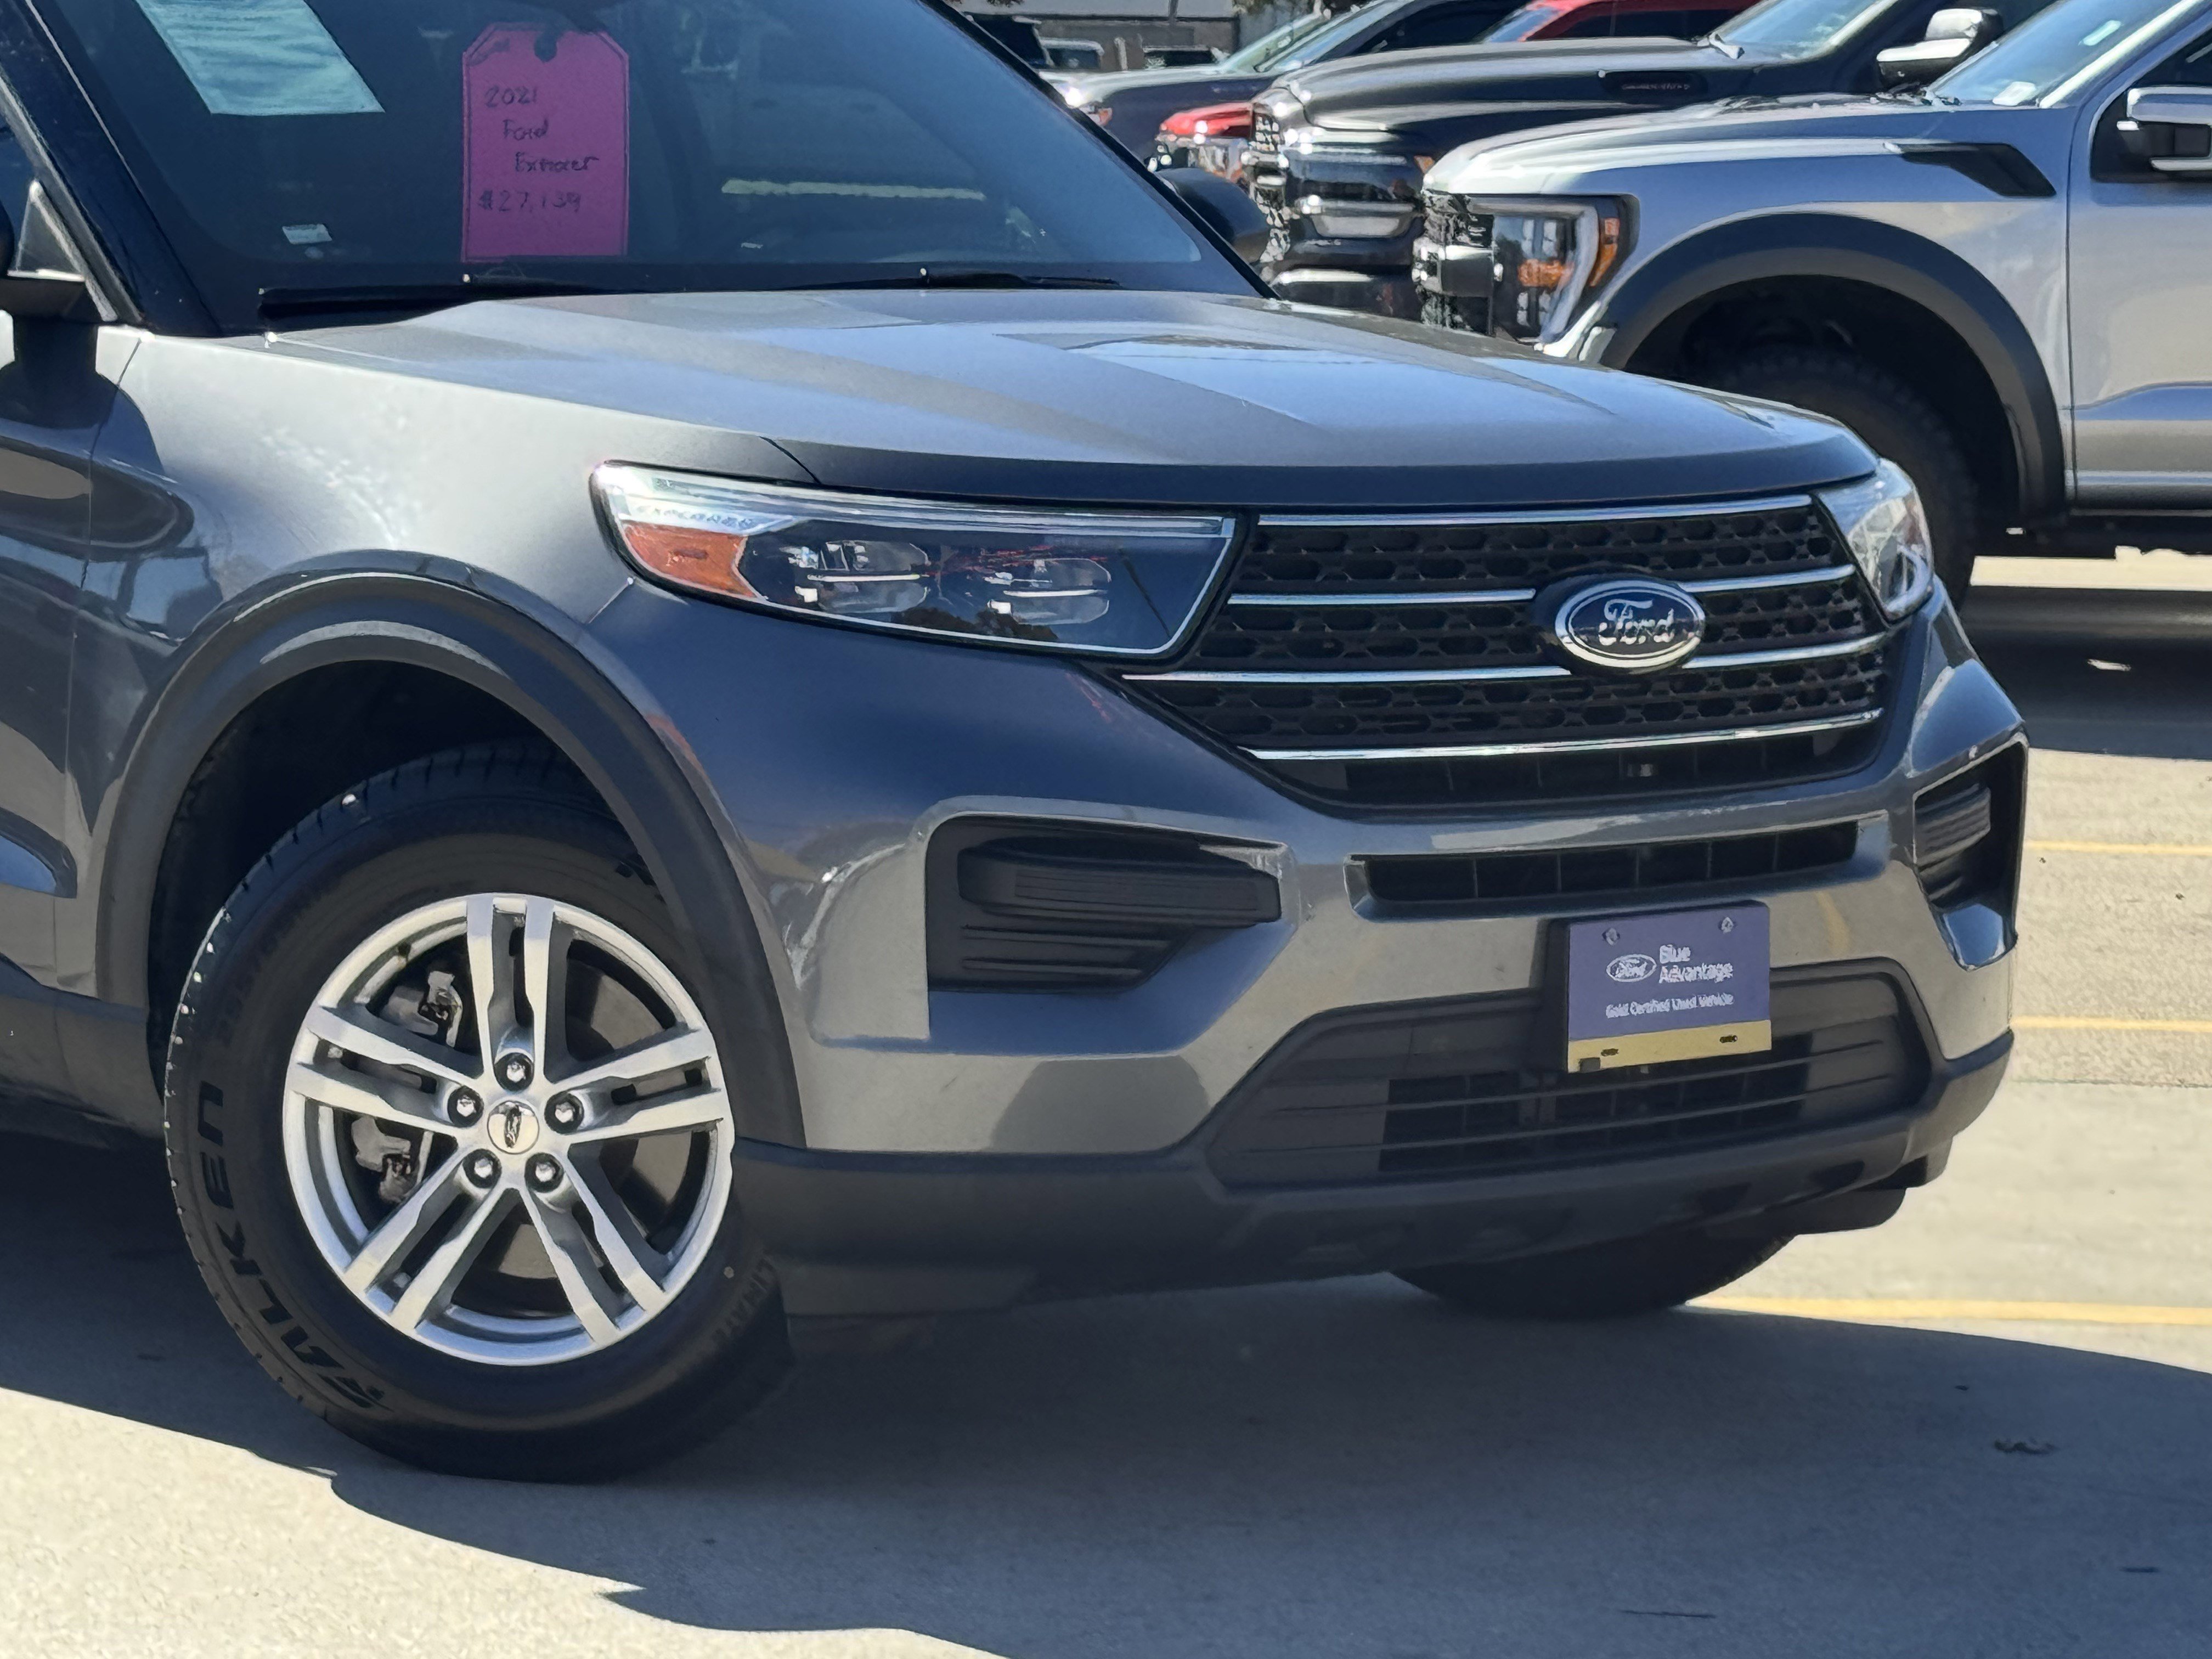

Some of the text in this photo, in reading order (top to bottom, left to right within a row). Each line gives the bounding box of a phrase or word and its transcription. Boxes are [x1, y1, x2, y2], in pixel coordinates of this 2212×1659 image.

[486, 86, 538, 108] 2021
[503, 117, 548, 141] Ford
[1598, 598, 1674, 646] Ford
[1660, 944, 1691, 964] Blue
[1658, 962, 1733, 984] Advantage
[1605, 1002, 1630, 1018] Gold
[1630, 998, 1671, 1015] Certified
